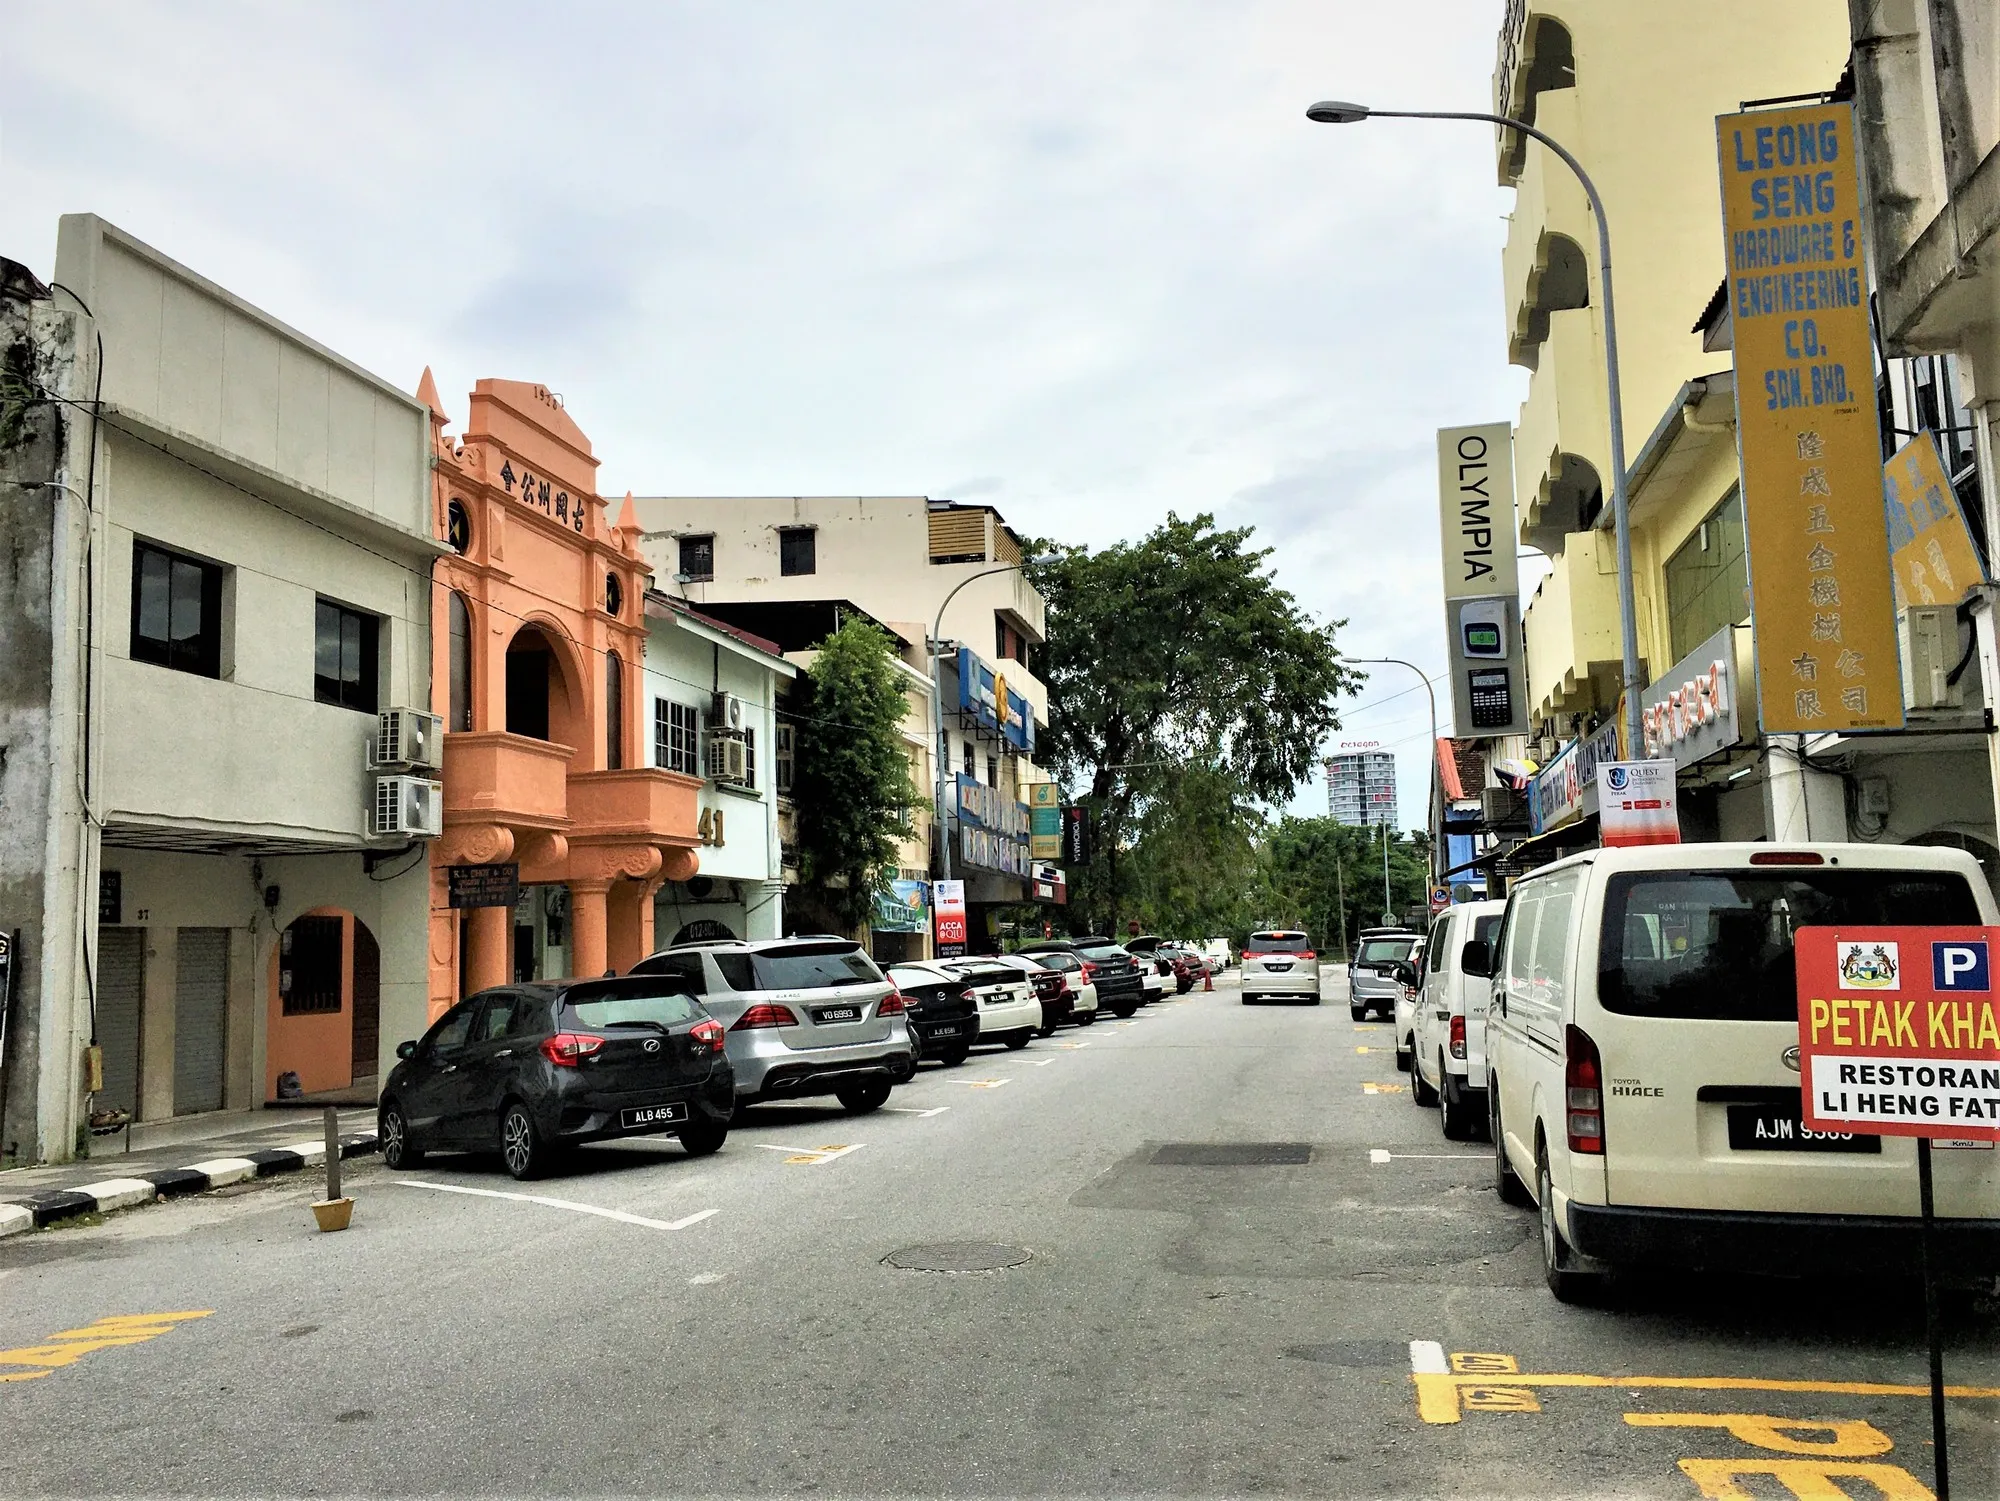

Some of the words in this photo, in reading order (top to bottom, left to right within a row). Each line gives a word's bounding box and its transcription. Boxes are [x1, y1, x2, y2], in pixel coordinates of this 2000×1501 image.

[1733, 119, 1839, 173] LEONG
[1751, 170, 1835, 220] SENG
[1733, 221, 1835, 271] HARDWARE
[1842, 219, 1855, 260] &
[1736, 267, 1860, 318] ENGINEERING
[1783, 318, 1827, 360] CO.
[1457, 435, 1494, 582] OLYMPIA
[1630, 768, 1660, 777] QUEST
[698, 807, 725, 848] 41
[137, 909, 149, 920] 37
[939, 921, 962, 930] ACCA
[1943, 947, 1977, 985] P
[1810, 999, 1919, 1048] PETAK
[1927, 1001, 2000, 1050] KHA
[1612, 1086, 1665, 1097] HIACE
[1839, 1064, 2000, 1090] RESTORAN
[635, 1110, 654, 1123] ALB
[655, 1108, 673, 1120] 455
[1822, 1091, 1848, 1112] LI
[1857, 1093, 1940, 1116] HENG
[1949, 1097, 2000, 1119] FAT
[1755, 1118, 1793, 1139] AJM
